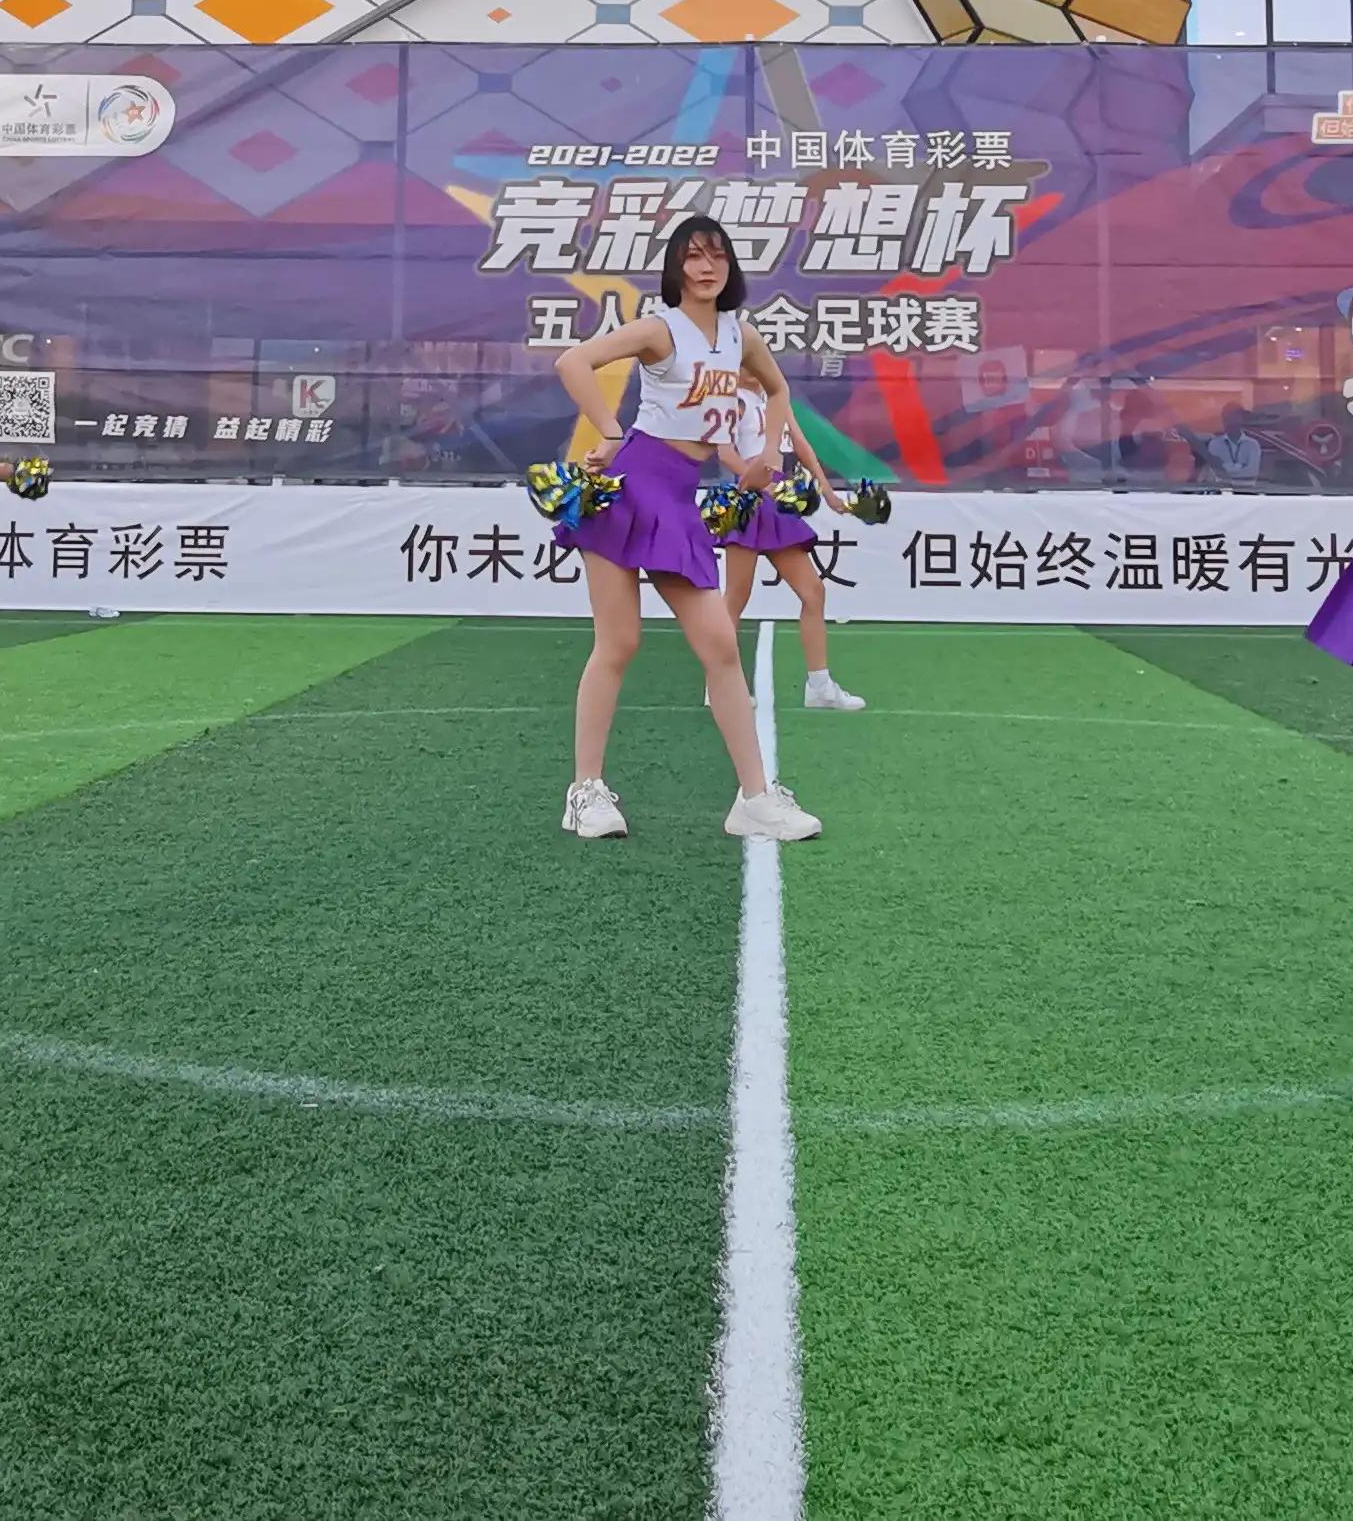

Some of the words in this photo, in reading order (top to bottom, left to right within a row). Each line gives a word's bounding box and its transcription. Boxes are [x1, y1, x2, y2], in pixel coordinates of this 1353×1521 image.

[528, 145, 719, 167] 2021-2022
[746, 129, 1012, 170] 中国体育彩票
[480, 179, 1028, 273] 竞彩梦想杯
[528, 296, 979, 353] 五人余足球赛
[74, 414, 190, 439] 一起竞猜
[213, 418, 334, 444] 益起精彩
